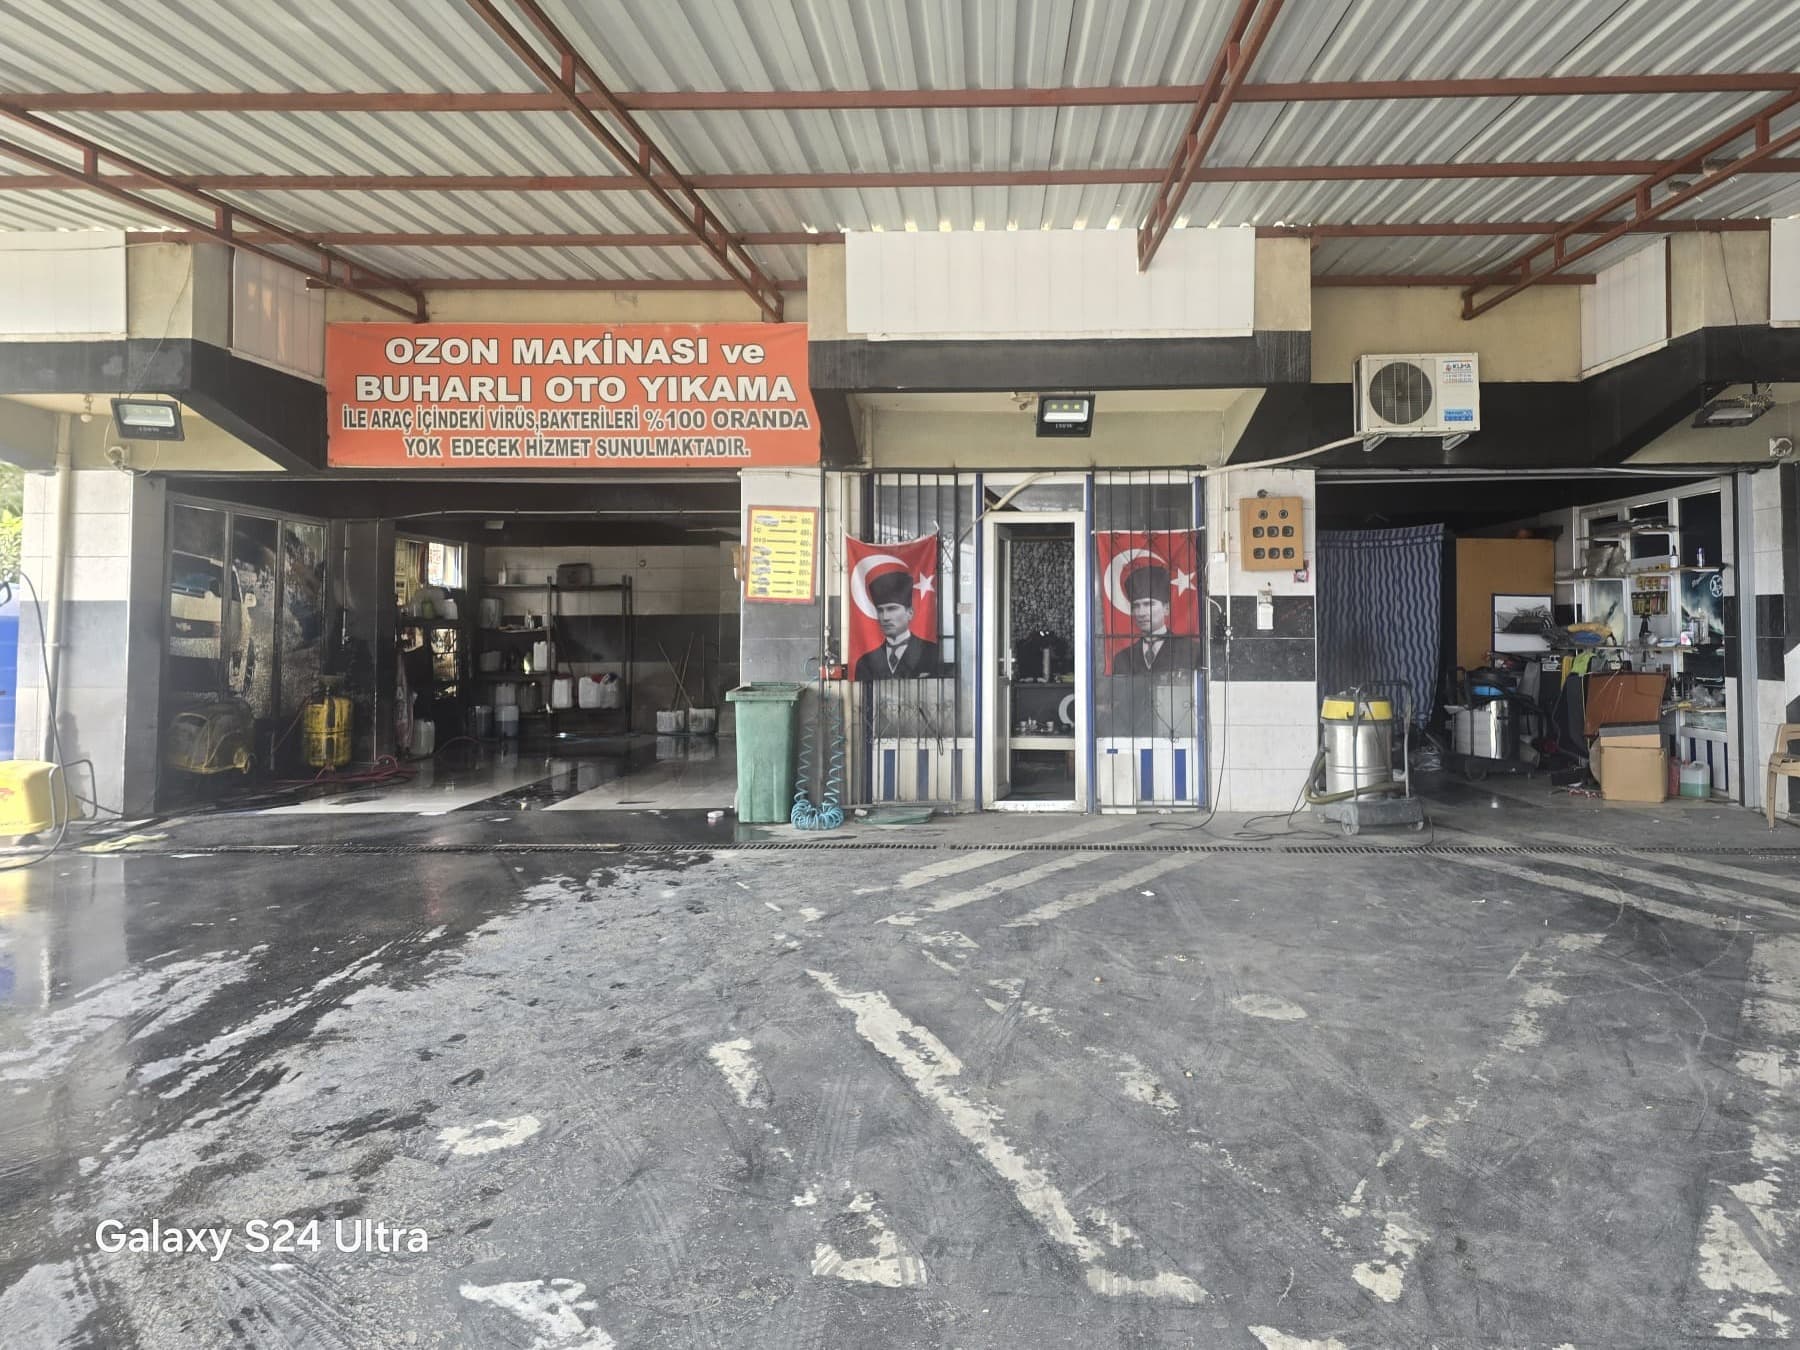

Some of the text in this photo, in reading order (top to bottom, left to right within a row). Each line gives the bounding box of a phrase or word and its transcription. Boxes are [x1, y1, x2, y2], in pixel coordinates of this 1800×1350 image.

[385, 331, 765, 364] OZON MAKİNASI ve
[356, 376, 797, 402] BUHARLI OTO YIKAMA
[343, 406, 367, 429] İLE
[371, 409, 412, 432] ARAÇ
[417, 406, 485, 432] İÇİNDEKİ
[645, 410, 706, 430] %100
[713, 410, 809, 429] ORANDA
[405, 434, 749, 457] YOK EDECEK HİZMET SUNULMAKTADIR.
